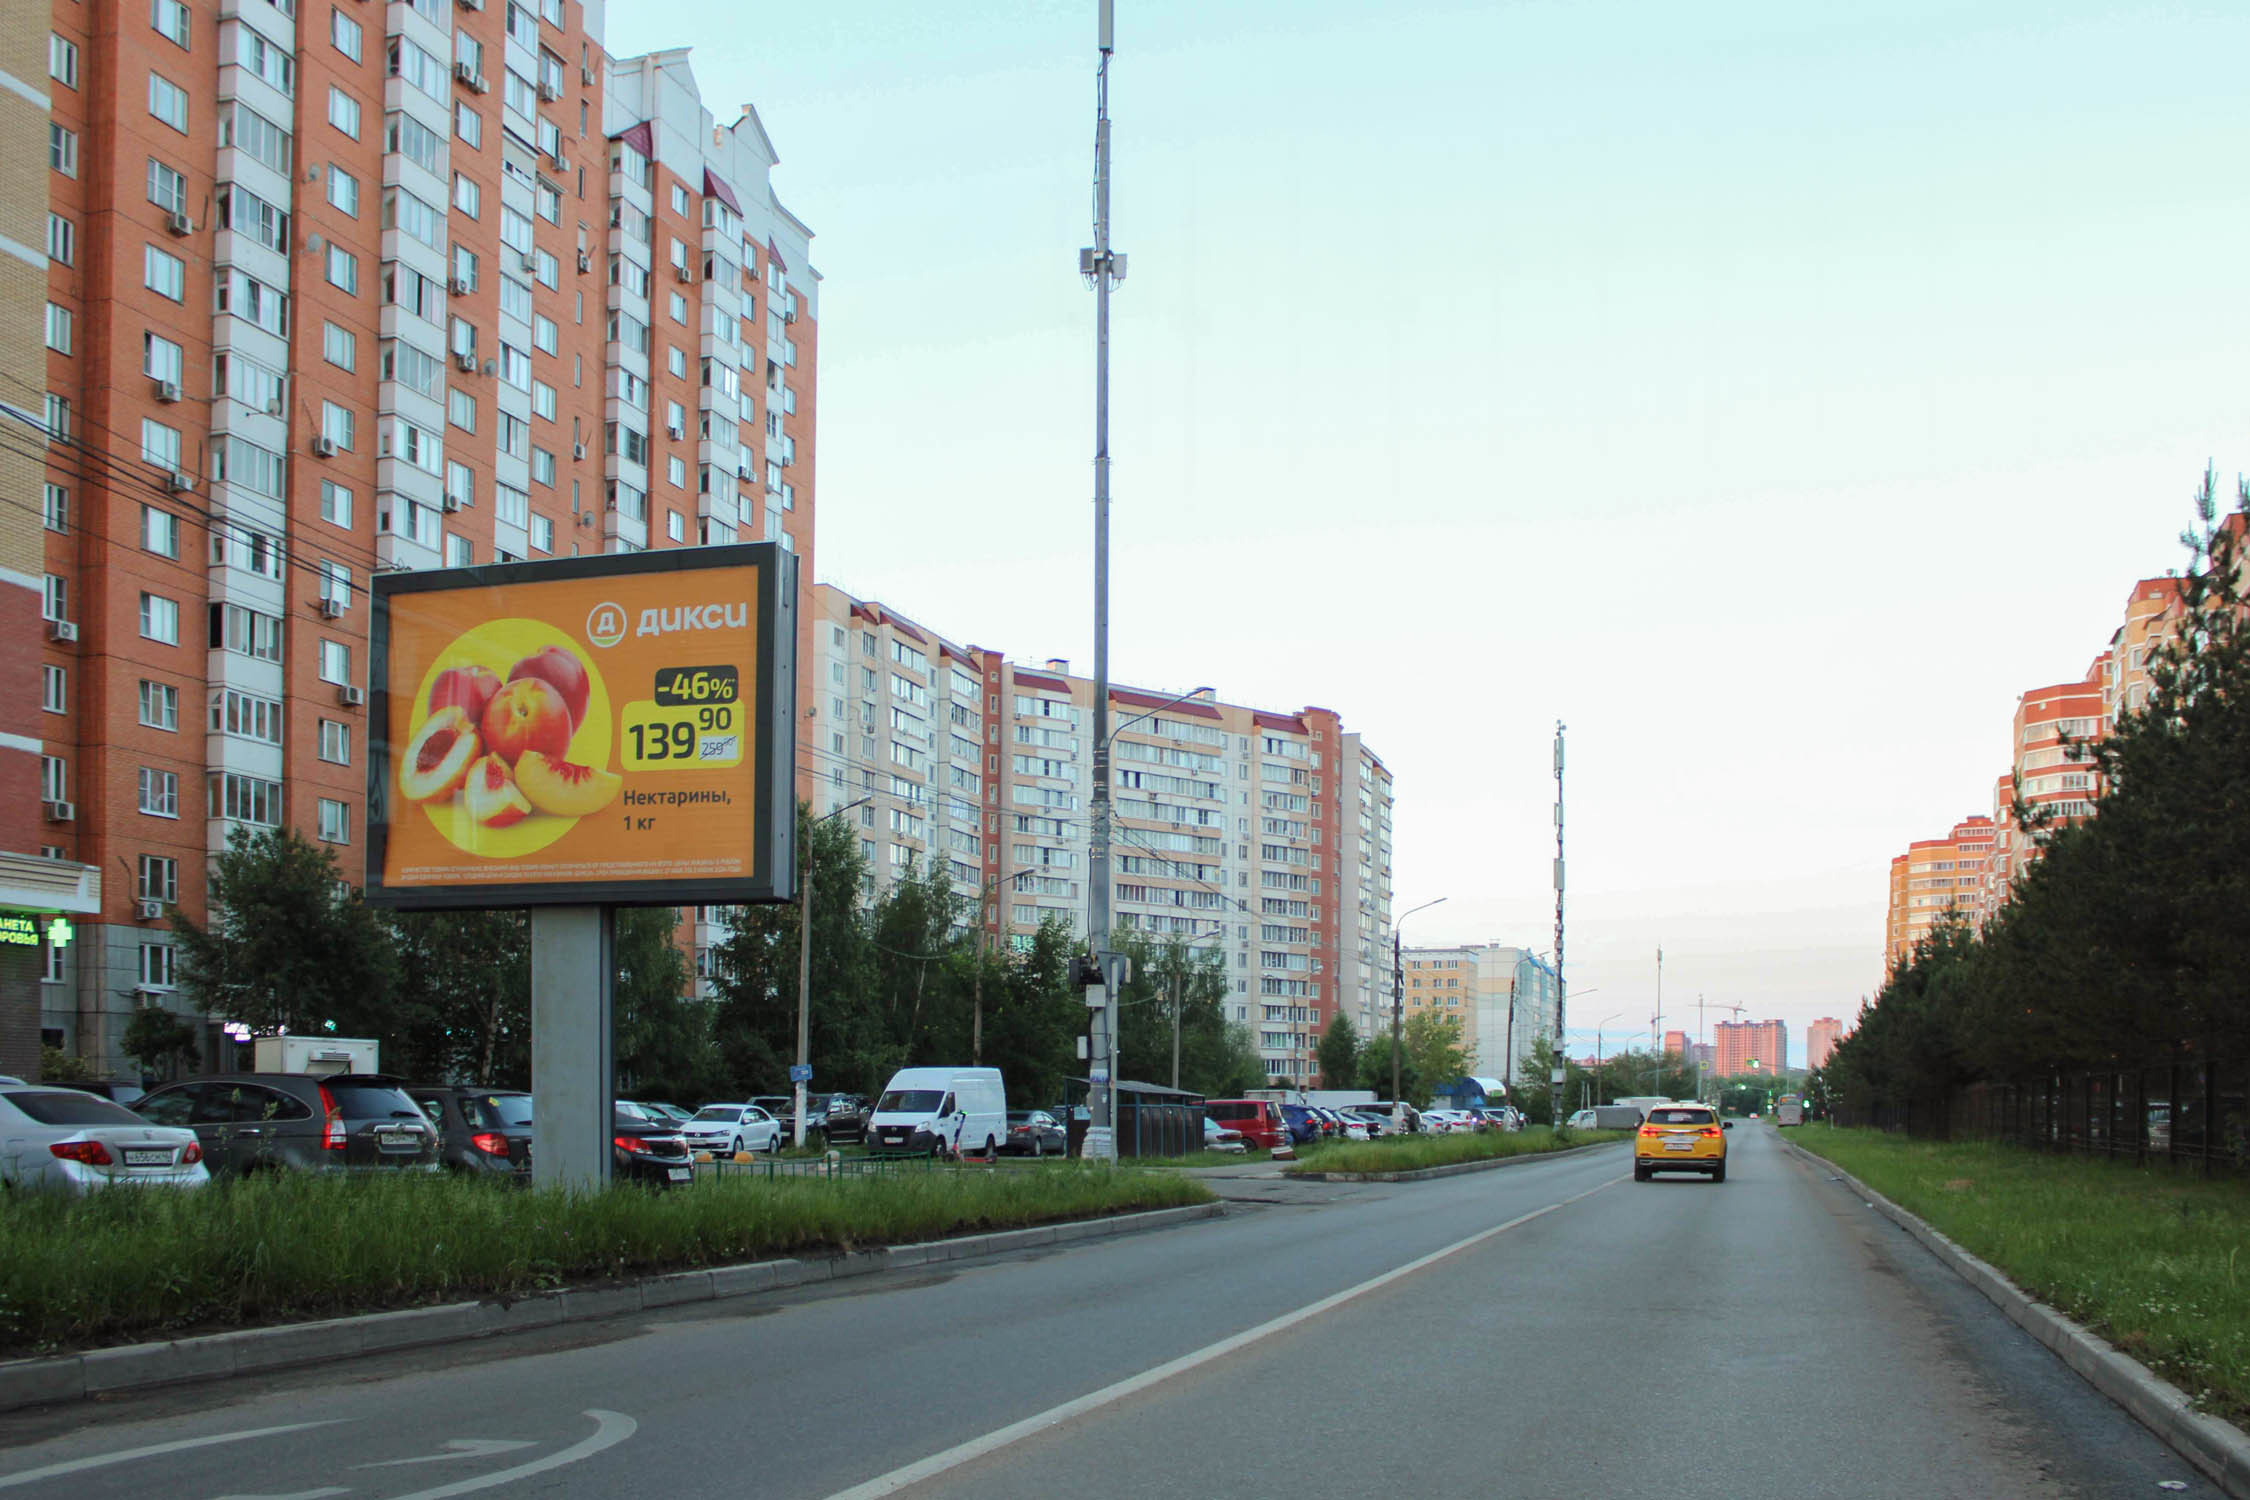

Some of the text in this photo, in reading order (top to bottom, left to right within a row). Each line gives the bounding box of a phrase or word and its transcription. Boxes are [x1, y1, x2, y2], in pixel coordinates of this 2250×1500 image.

[629, 707, 731, 760] 139 90
[623, 789, 731, 807] Нектарины,
[624, 816, 656, 830] 1 кг
[0, 930, 39, 945] РОВЬЯ
